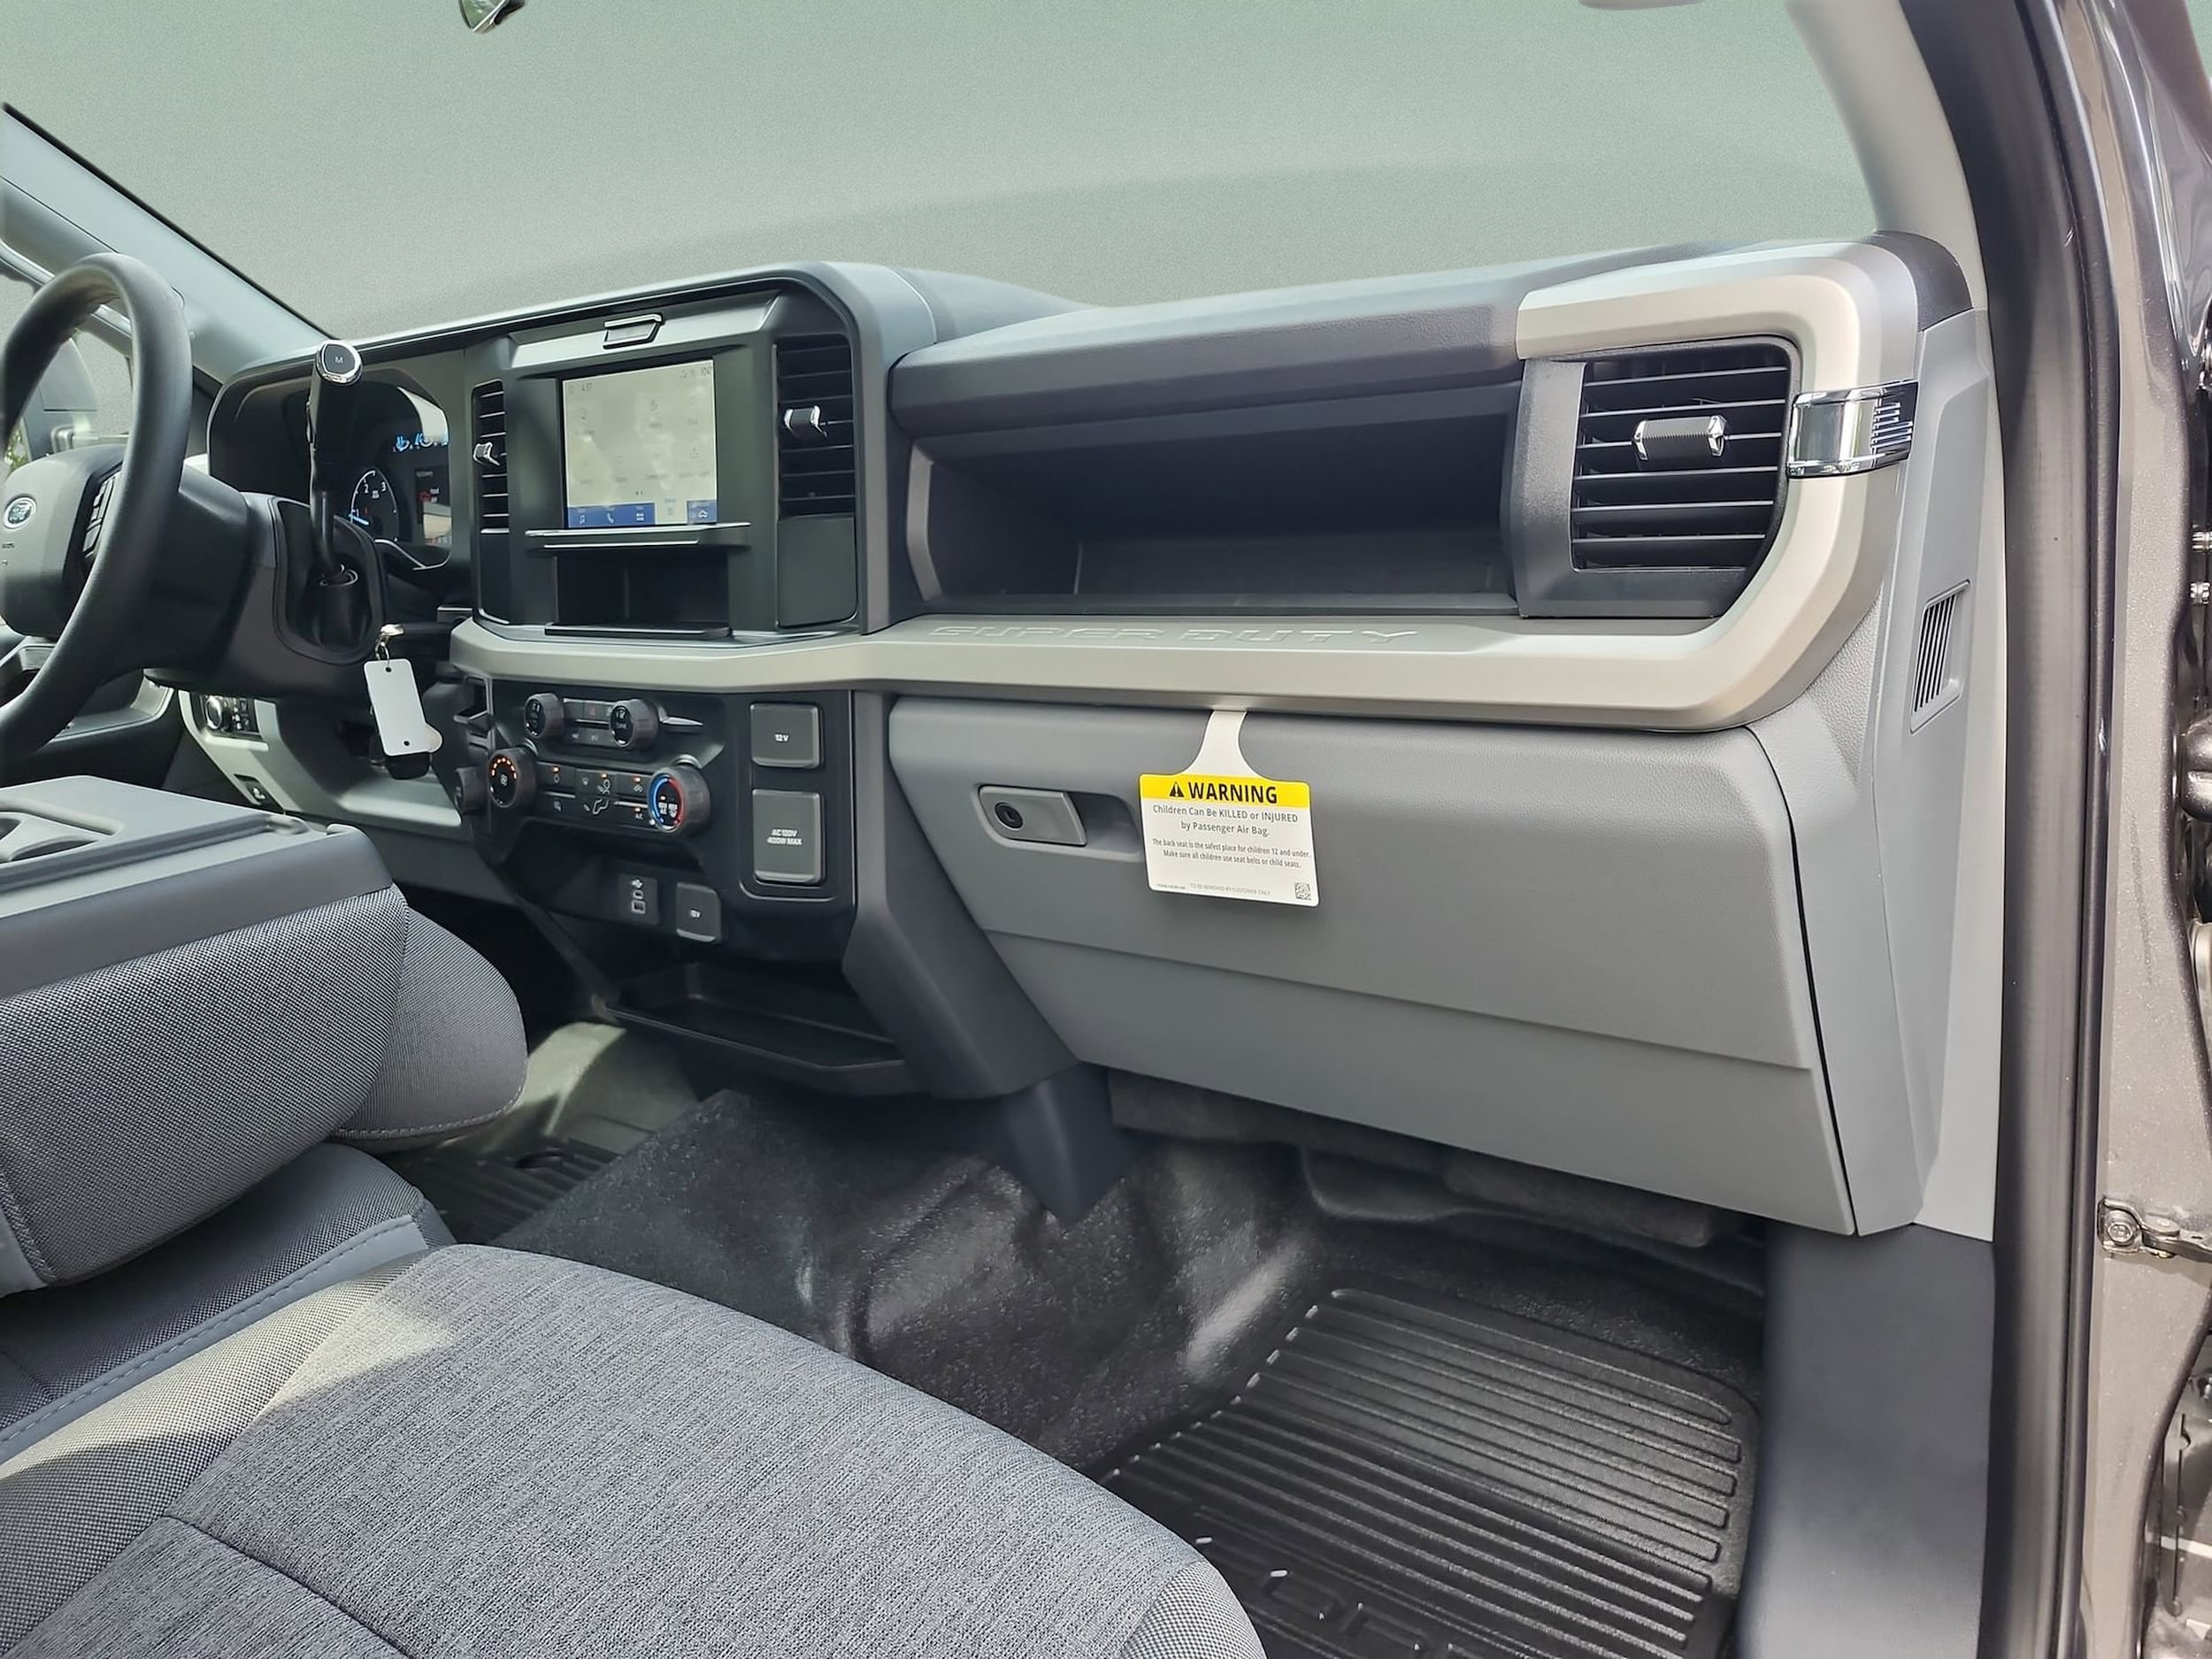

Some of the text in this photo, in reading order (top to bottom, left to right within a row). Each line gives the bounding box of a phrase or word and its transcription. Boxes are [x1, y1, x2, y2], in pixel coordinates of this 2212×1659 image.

[929, 626, 1418, 644] SUPER DUTY
[1187, 781, 1278, 803] WARNING
[1153, 805, 1187, 814] Children
[1189, 807, 1204, 816] Can
[1207, 809, 1217, 818] Be
[1219, 809, 1248, 819] KILLED
[1262, 812, 1298, 823] INJURED
[1180, 820, 1271, 837] by Passenger Air Bag.
[1222, 843, 1237, 852] place
[1237, 844, 1246, 853] for
[1247, 846, 1271, 855] children
[1163, 849, 1179, 858] Make
[1269, 858, 1283, 867] child
[1284, 860, 1302, 869] seats.
